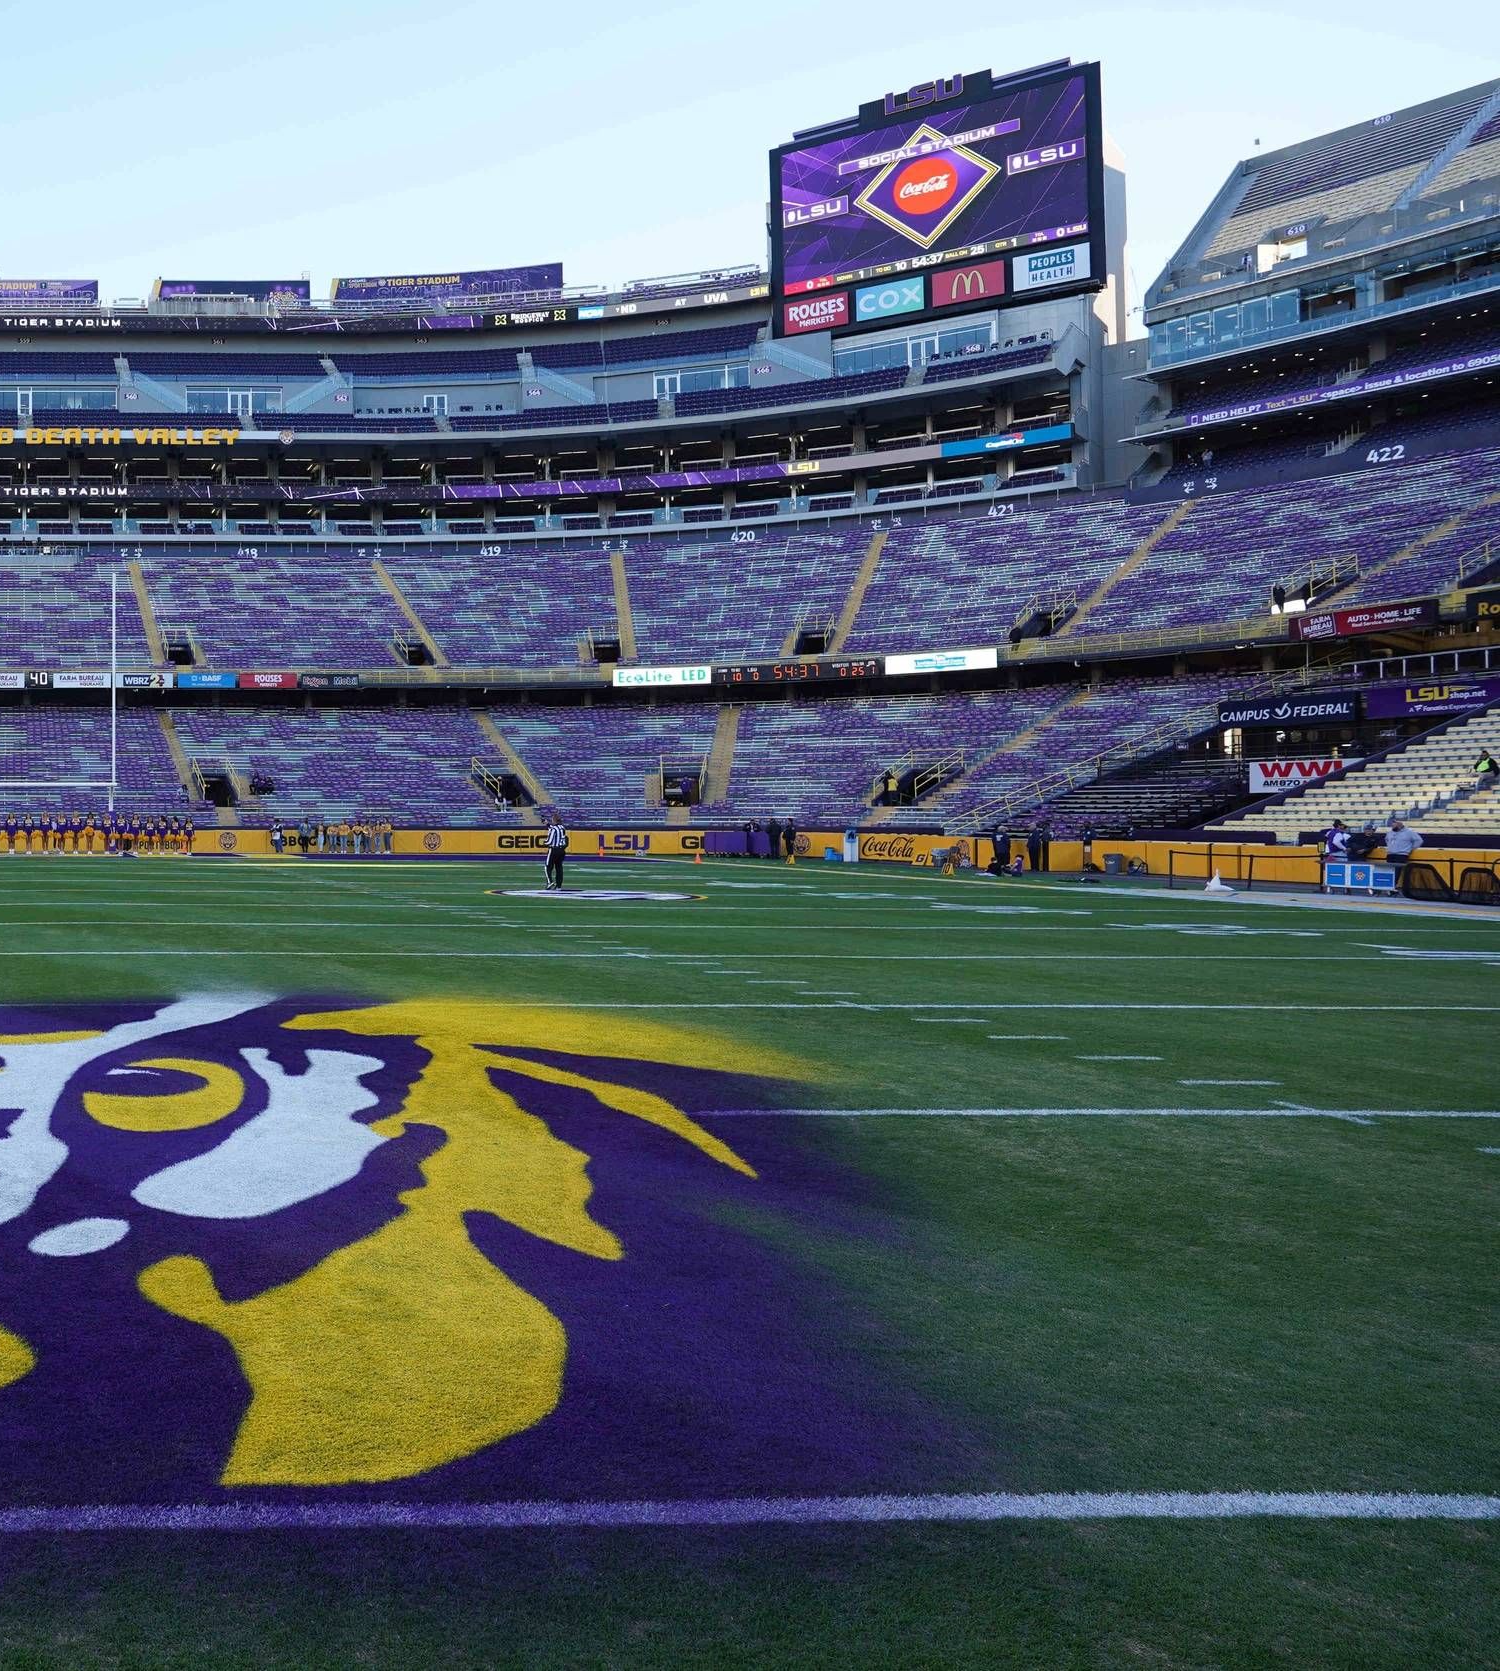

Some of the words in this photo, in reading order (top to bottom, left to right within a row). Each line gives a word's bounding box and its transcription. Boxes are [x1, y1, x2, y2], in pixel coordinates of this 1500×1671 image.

[885, 73, 963, 116] LSU
[1374, 115, 1392, 126] 610
[858, 146, 917, 169] SOCIAL
[921, 127, 996, 153] STADIUM
[1023, 144, 1076, 167] LSU
[900, 174, 950, 198] Coca-Cola
[797, 200, 841, 220] LSU
[1288, 225, 1305, 236] 610
[806, 280, 814, 290] 0
[859, 270, 865, 279] 1
[894, 261, 907, 271] 10
[912, 253, 943, 268] 54:37
[970, 245, 984, 255] 25
[1011, 238, 1017, 248] 1
[1056, 228, 1064, 237] 0
[1066, 223, 1087, 234] LSU
[1031, 252, 1074, 268] PEOPLES
[387, 278, 415, 287] TIGER
[417, 275, 460, 286] STADIUM
[1031, 267, 1073, 282] HEALTH
[703, 293, 728, 303] UVA
[859, 284, 922, 313] COX
[510, 311, 550, 321] BRIDGEWAY
[788, 297, 845, 322] ROUSES
[4, 318, 48, 327] TIGER
[55, 318, 122, 328] STADIUM
[799, 313, 835, 328] MARKETS
[966, 344, 980, 352] 568
[1202, 411, 1228, 422] NEED
[1230, 404, 1261, 418] HELP?
[1265, 400, 1286, 410] Text
[1287, 393, 1318, 406] "LSU"
[1319, 386, 1363, 401] <space>
[1364, 378, 1392, 391] issue
[1393, 375, 1403, 384] &
[1405, 366, 1450, 383] location
[1452, 363, 1464, 371] to
[25, 428, 120, 445] DEATH
[132, 428, 240, 445] VALLEY
[1367, 445, 1405, 464] 422
[788, 461, 819, 474] LSU
[4, 487, 50, 496] TIGER
[58, 487, 127, 496] STADIUM
[988, 504, 1014, 517] 421
[731, 531, 755, 543] 420
[238, 548, 258, 559] 418
[481, 546, 501, 557] 419
[1310, 615, 1331, 625] FARM
[1347, 614, 1369, 624] AUTO
[1374, 610, 1399, 619] HOME
[1404, 606, 1422, 616] LIFE
[1303, 621, 1333, 634] BUREAU
[202, 674, 222, 682] BASF
[254, 673, 282, 684] ROUSES
[682, 669, 706, 681] LED
[732, 672, 742, 681] 10
[753, 671, 760, 680] 0
[774, 663, 819, 679] 54:37
[840, 667, 846, 677] 0
[852, 666, 865, 676] 25
[30, 673, 47, 685] 40
[124, 676, 150, 685] WBRZ
[150, 674, 160, 687] 2
[302, 676, 328, 687] Exxon
[334, 676, 359, 686] Mobil
[1220, 708, 1270, 723] CAMPUS
[1293, 703, 1350, 716] FEDERAL
[598, 834, 650, 851] LSU
[861, 836, 914, 858] Coca-Cola
[942, 863, 950, 873] 10
